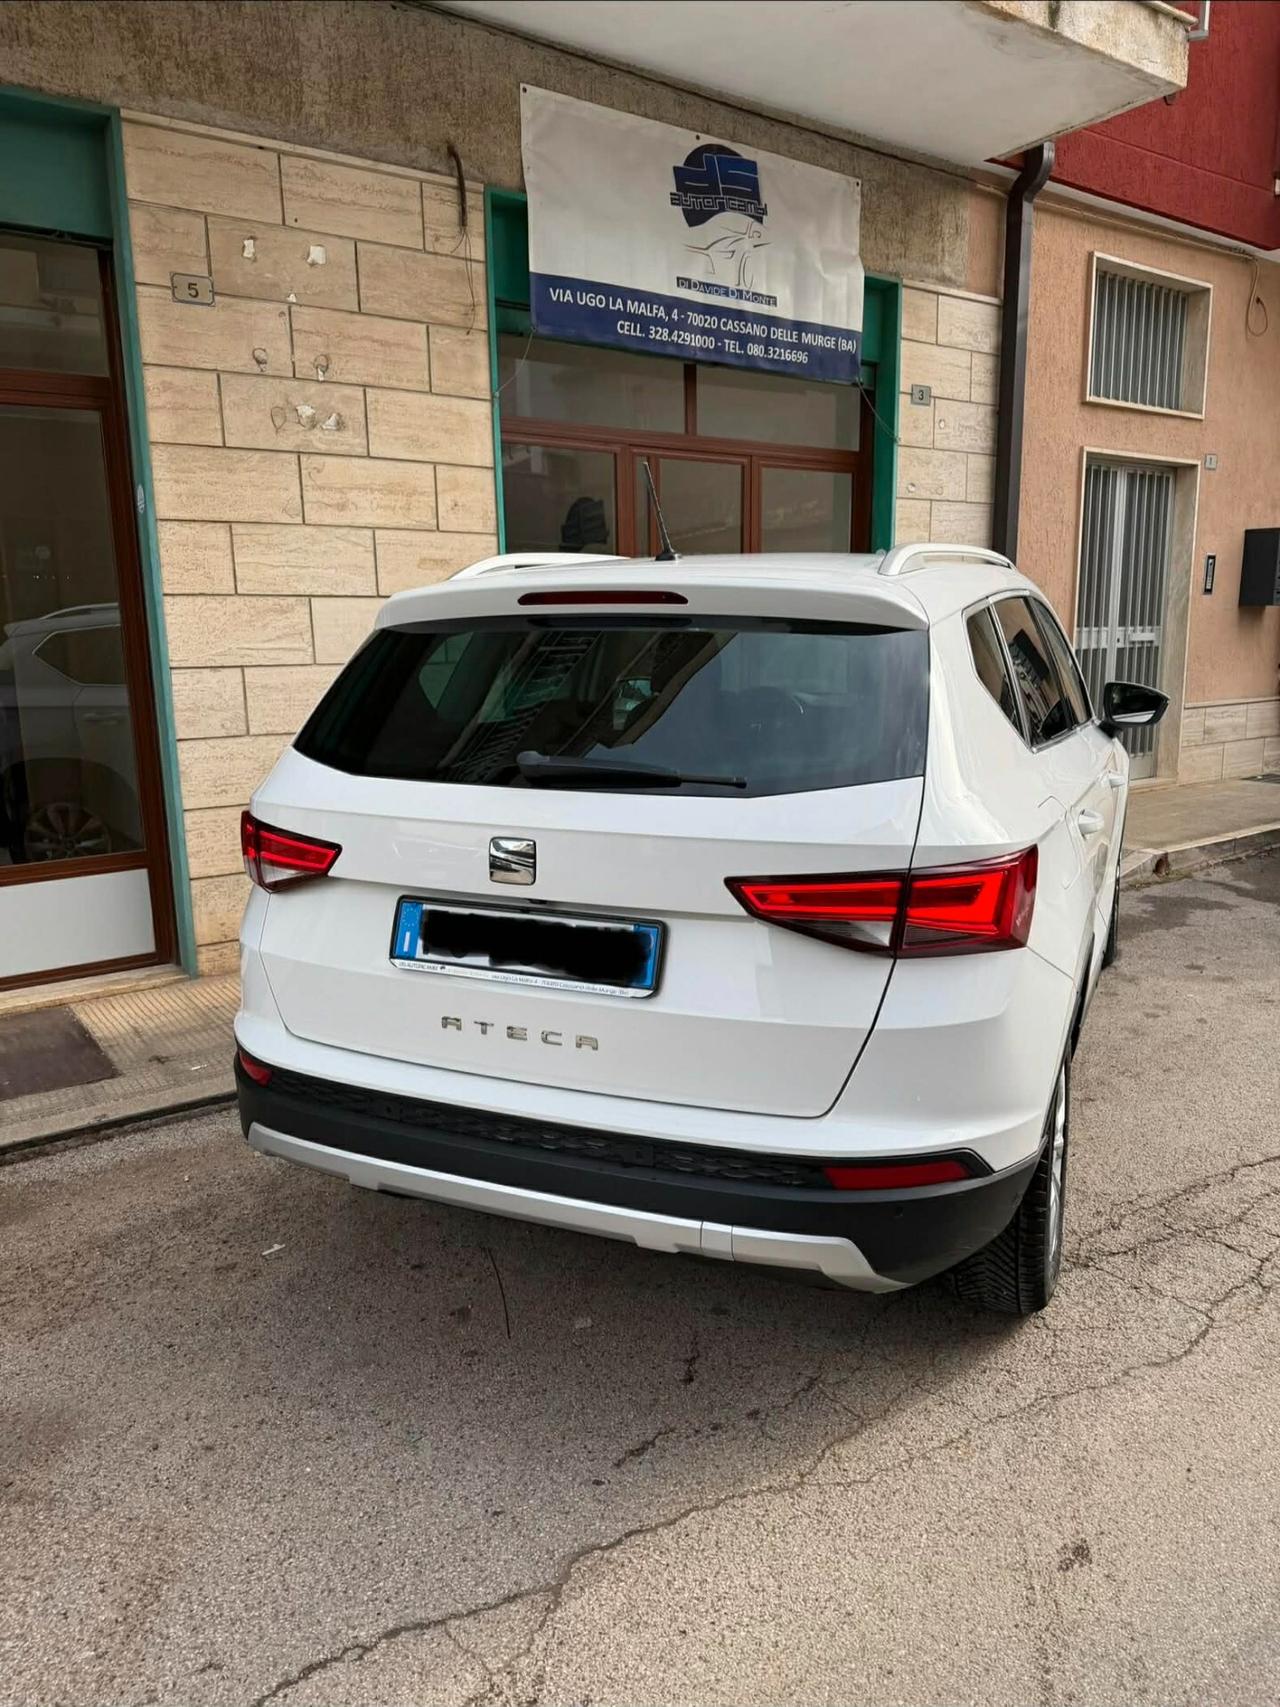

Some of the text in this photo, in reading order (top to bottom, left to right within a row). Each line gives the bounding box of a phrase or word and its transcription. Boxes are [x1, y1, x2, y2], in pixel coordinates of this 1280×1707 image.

[187, 282, 199, 299] 5
[549, 287, 574, 303] VIA
[576, 291, 606, 309] UGO
[609, 297, 624, 312] LA
[626, 300, 669, 322] MALFA,
[671, 308, 679, 321] 4
[687, 311, 718, 329] 70020
[720, 318, 768, 338] CASSANO
[770, 327, 799, 343] DELLE
[801, 332, 836, 349] MURGE
[838, 336, 857, 354] (BA)
[617, 320, 645, 338] CELL.
[648, 325, 715, 349] 328.4291000
[724, 339, 744, 354] TEL.
[747, 343, 809, 364] 080.3216696
[918, 389, 925, 401] 3
[403, 931, 411, 952] I
[441, 1015, 599, 1051] ATECA
